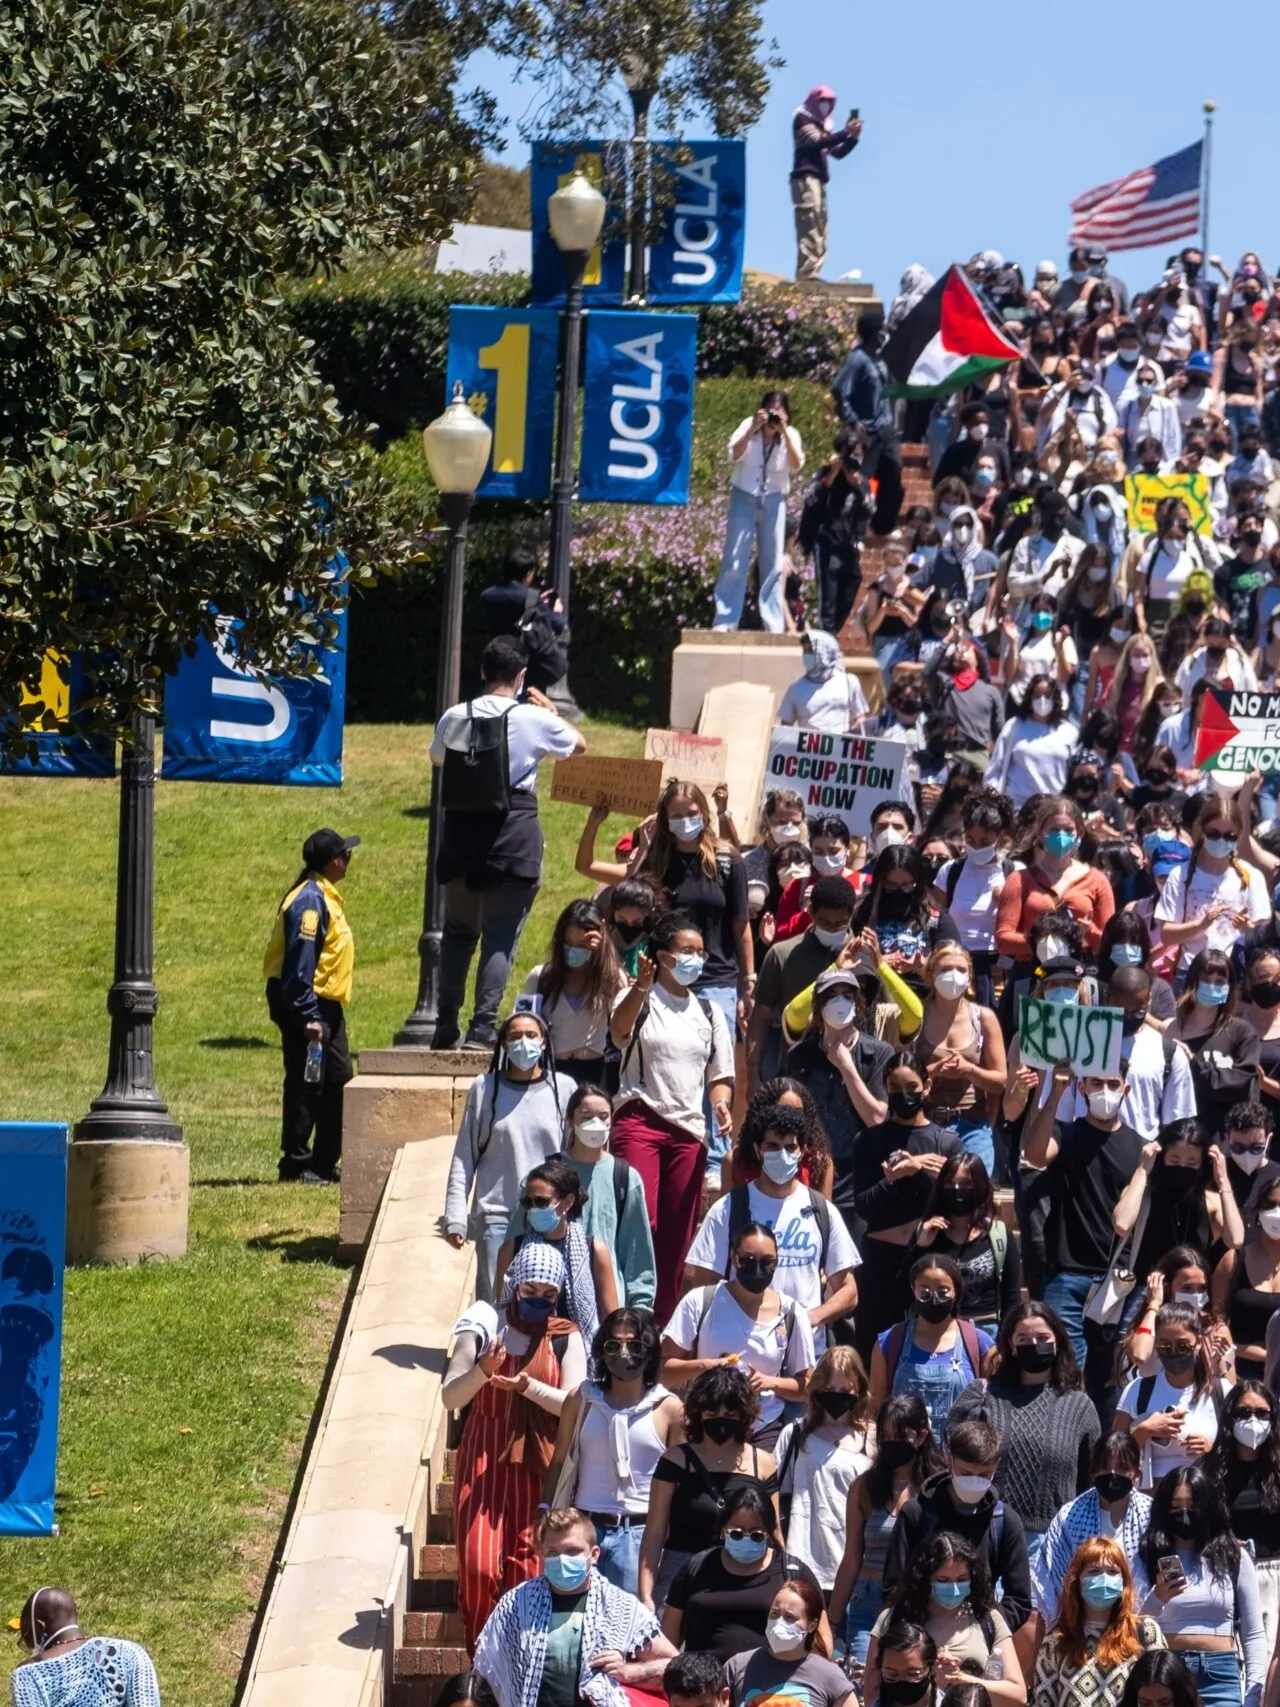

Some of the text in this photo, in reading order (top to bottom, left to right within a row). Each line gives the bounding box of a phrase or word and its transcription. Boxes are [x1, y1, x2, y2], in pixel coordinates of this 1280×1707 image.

[671, 154, 718, 286] UCLA
[466, 323, 531, 474] #1
[607, 330, 665, 481] UCLA
[1229, 692, 1262, 717] NO
[796, 732, 877, 762] END THE
[771, 754, 895, 790] OCCUPATION
[554, 784, 588, 800] FREE
[807, 784, 857, 811] NOW
[1019, 995, 1124, 1072] RESIST
